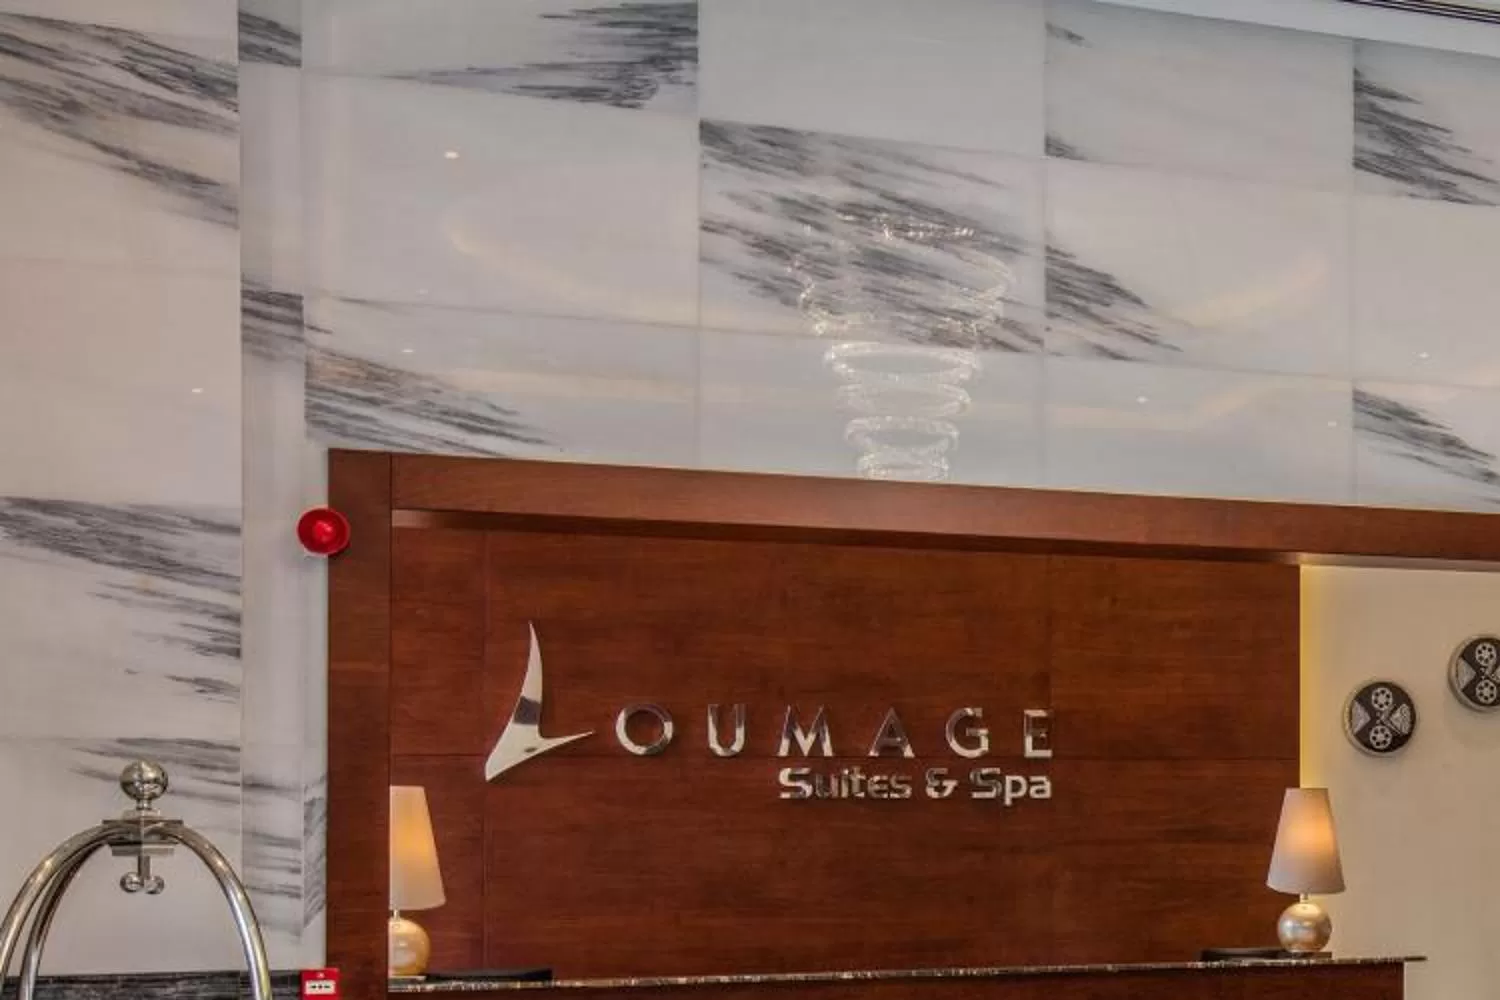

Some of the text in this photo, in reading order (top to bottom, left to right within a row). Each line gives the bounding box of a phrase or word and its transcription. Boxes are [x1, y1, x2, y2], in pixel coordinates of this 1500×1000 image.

[779, 767, 1053, 805] Suites & Spa
